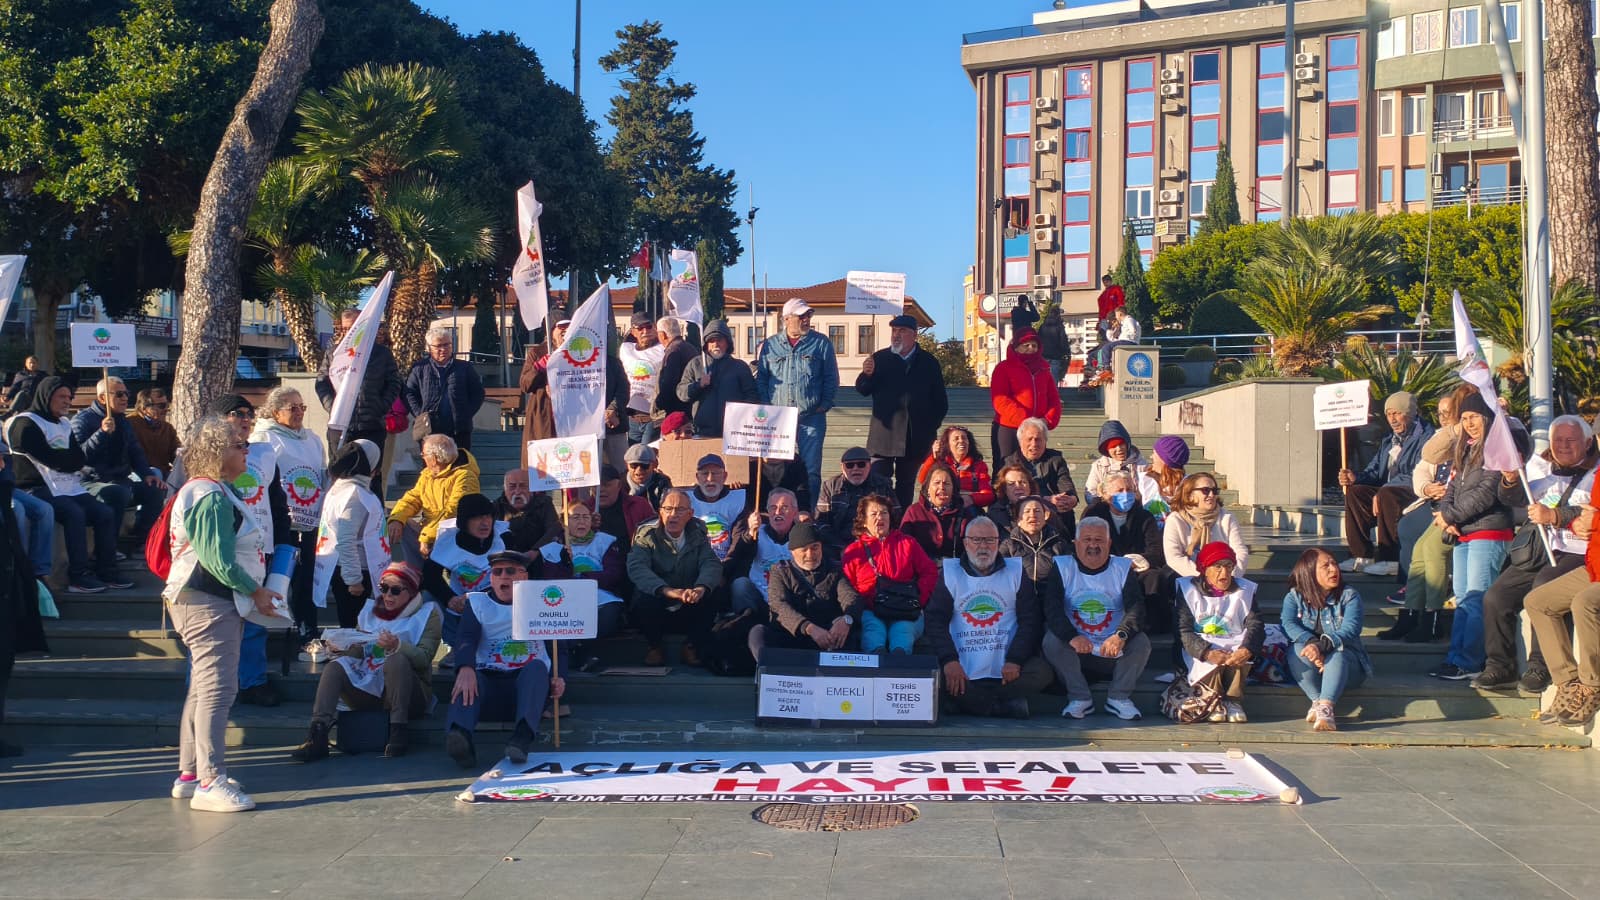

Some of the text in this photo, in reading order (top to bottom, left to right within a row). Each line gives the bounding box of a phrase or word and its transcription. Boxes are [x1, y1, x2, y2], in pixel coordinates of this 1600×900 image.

[529, 619, 584, 628] BİR YAŞAM İÇİN
[528, 628, 584, 636] ALANLARDAYIZ
[777, 680, 803, 689] TEŞHİS
[891, 682, 917, 690] TEŞHİS
[826, 686, 865, 697] EMEKLİ
[886, 693, 921, 702] STRES
[779, 705, 799, 713] ZAM
[520, 759, 1233, 778] AÇLIĞA VE SEFALETE
[550, 793, 1202, 804] TÜM EMEKLİLERİN SENDİKASI ANTALYA ŞUBESİ
